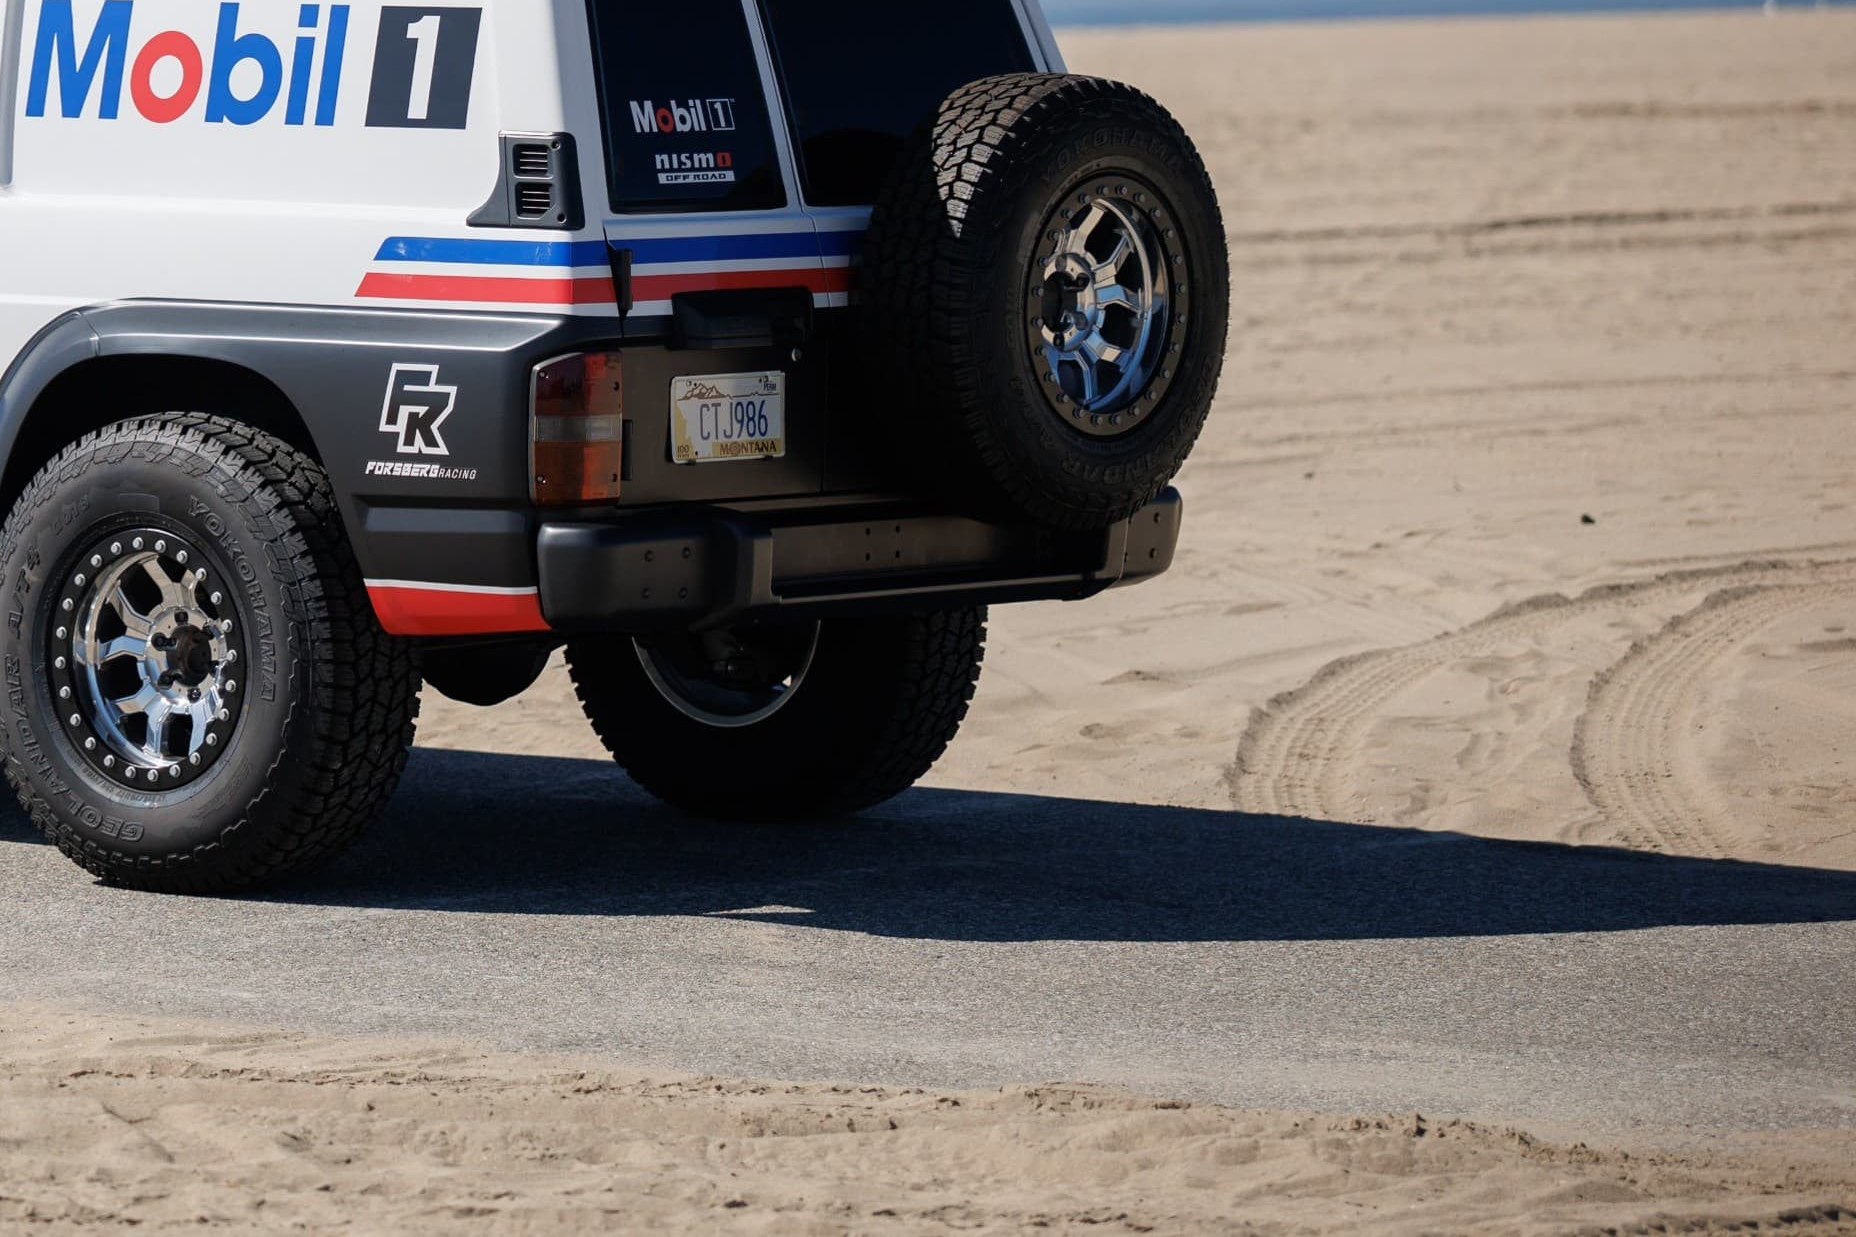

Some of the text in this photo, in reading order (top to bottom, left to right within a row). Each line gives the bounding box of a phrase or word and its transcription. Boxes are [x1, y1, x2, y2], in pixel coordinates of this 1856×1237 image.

[405, 14, 442, 121] 1
[629, 98, 707, 133] Mobil
[655, 152, 732, 170] nismo
[665, 172, 727, 183] OFF ROAD
[699, 399, 768, 441] CTJ986
[719, 440, 777, 457] MONTANA
[189, 494, 278, 703] YOKOHAMA
[5, 652, 145, 844] GEOLANDAR
